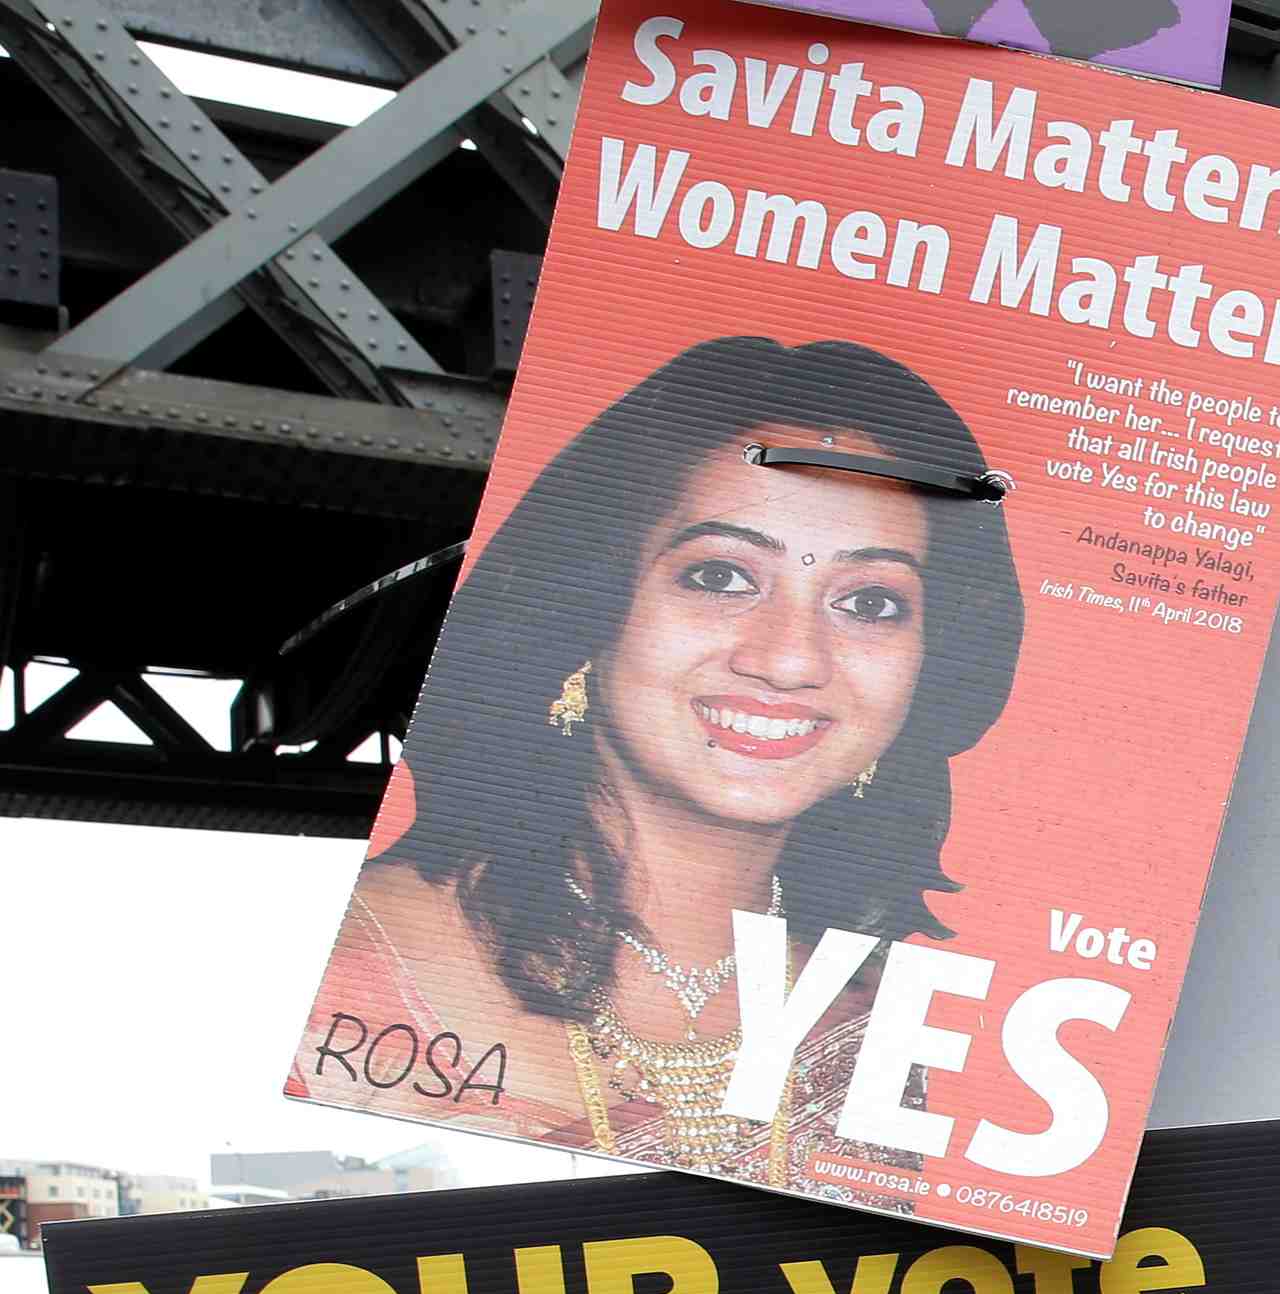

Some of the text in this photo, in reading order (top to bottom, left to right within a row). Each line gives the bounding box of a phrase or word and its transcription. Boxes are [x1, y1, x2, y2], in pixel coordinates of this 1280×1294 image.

[620, 15, 926, 159] Savita
[596, 136, 953, 296] Women
[1007, 387, 1120, 425] remember
[1125, 409, 1179, 437] her...
[1187, 418, 1195, 440] I
[1087, 373, 1143, 397] want
[1150, 380, 1183, 407] the
[1187, 390, 1261, 425] people
[1047, 460, 1270, 518] vote Yes for this law
[1067, 428, 1277, 491] that all Irish people
[1144, 506, 1165, 530] to
[1077, 526, 1188, 567] Andanappa
[1194, 548, 1255, 581] Yalagi,
[1039, 579, 1073, 599] Irish
[1078, 586, 1125, 612] Times,
[1152, 602, 1191, 625] April
[1194, 610, 1243, 634] 2018
[1111, 562, 1249, 608] Savita's father
[1046, 909, 1160, 971] Vote
[316, 1012, 508, 1107] ROSA
[722, 907, 1133, 1178] YES
[814, 1159, 1088, 1227] www.rosa.ie 0876418519
